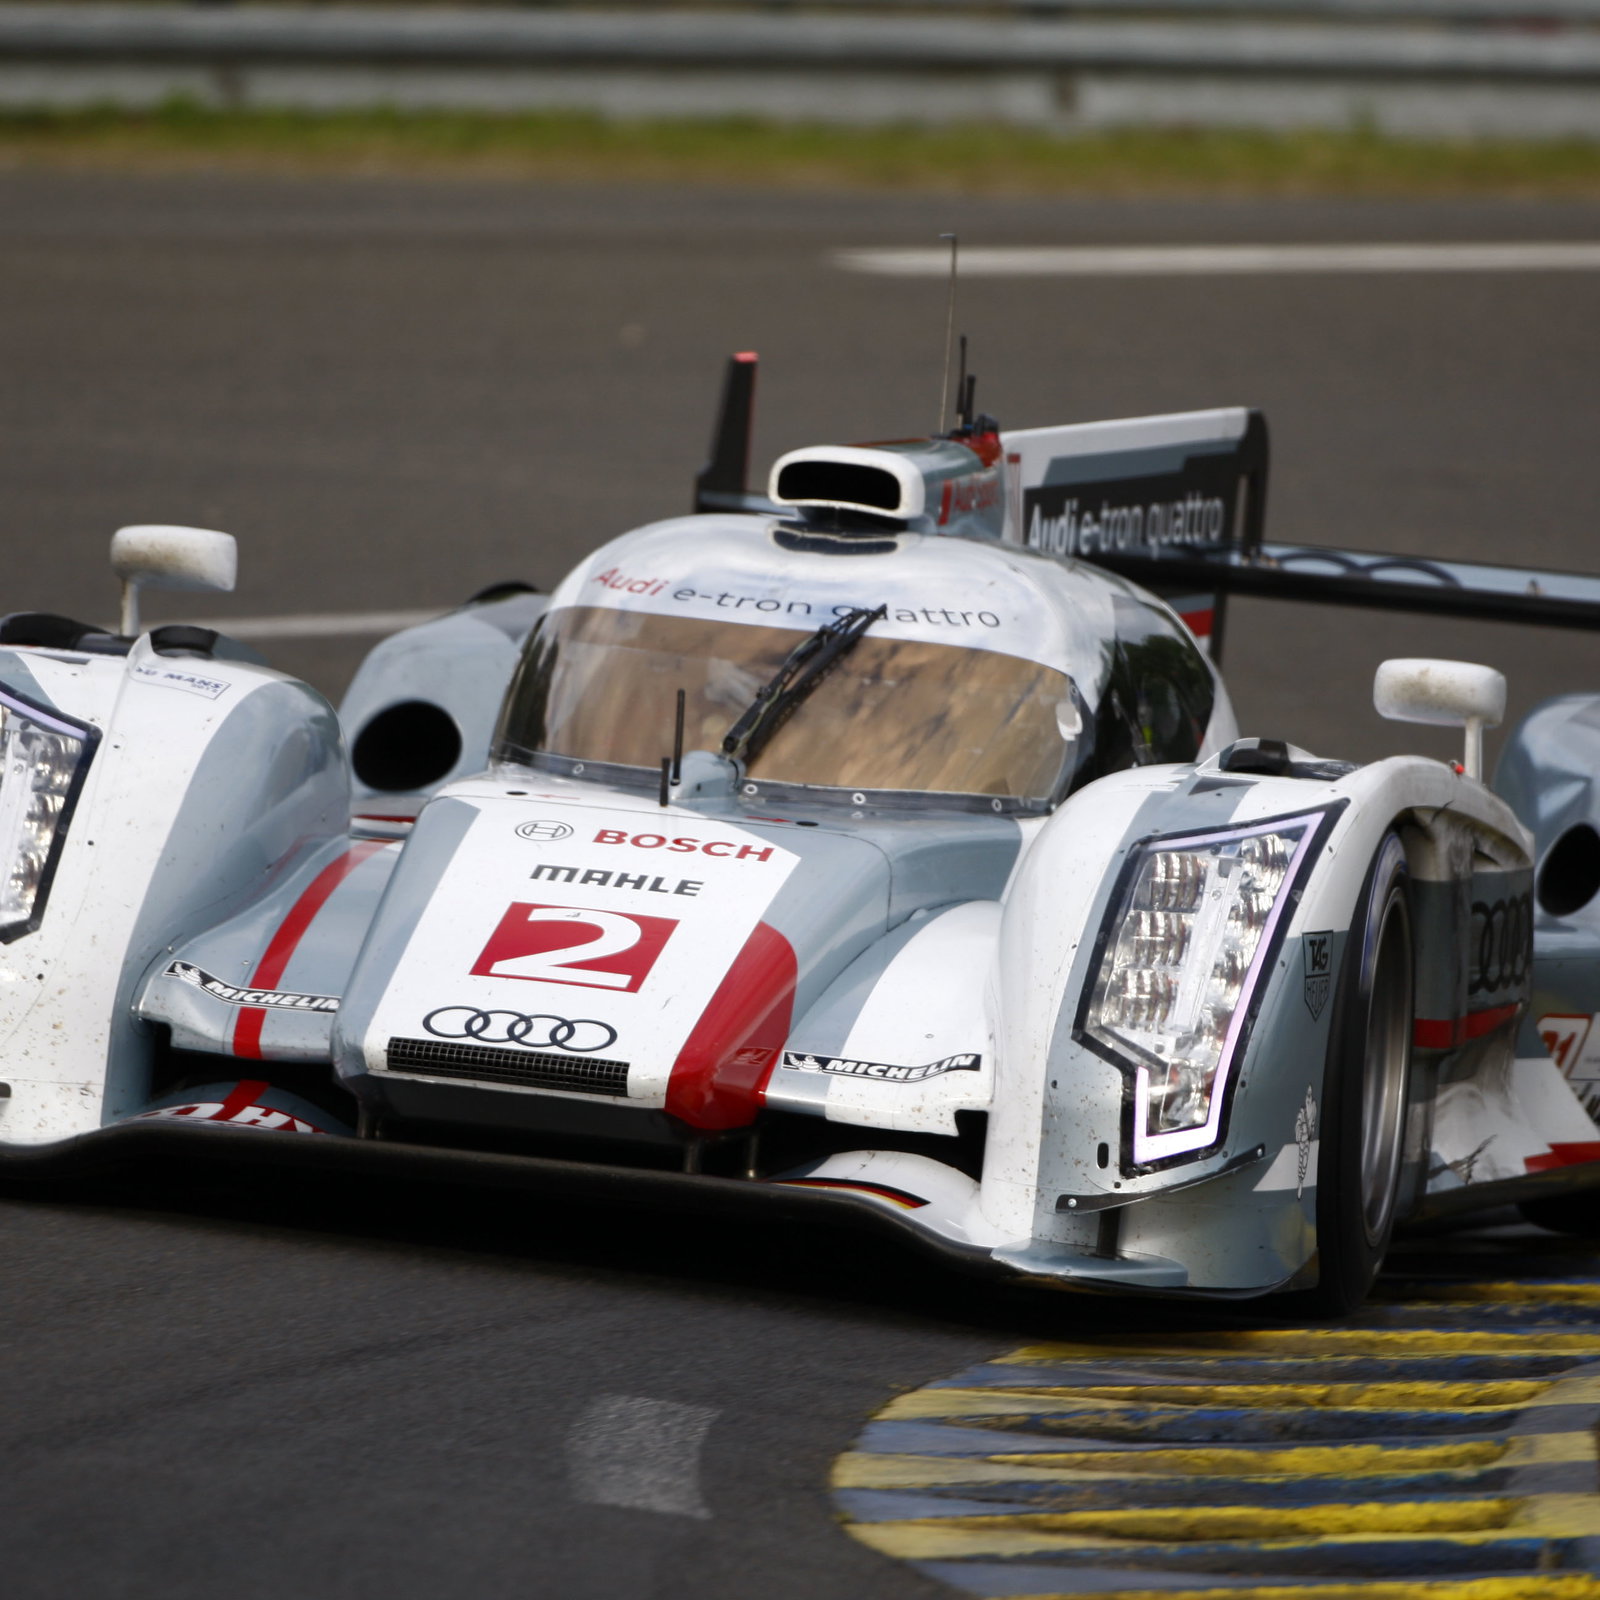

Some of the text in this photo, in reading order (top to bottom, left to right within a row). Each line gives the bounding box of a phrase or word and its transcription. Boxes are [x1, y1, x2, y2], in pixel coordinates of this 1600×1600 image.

[1029, 492, 1225, 560] Audi e-tron quattro
[592, 567, 665, 596] Audi
[672, 585, 811, 615] e-tron
[592, 829, 774, 862] BOSCH
[529, 864, 704, 897] MAHLE
[489, 907, 642, 989] 2
[1308, 936, 1329, 972] TAG
[205, 980, 341, 1010] MICHELIN
[826, 1054, 975, 1079] MICHELIN
